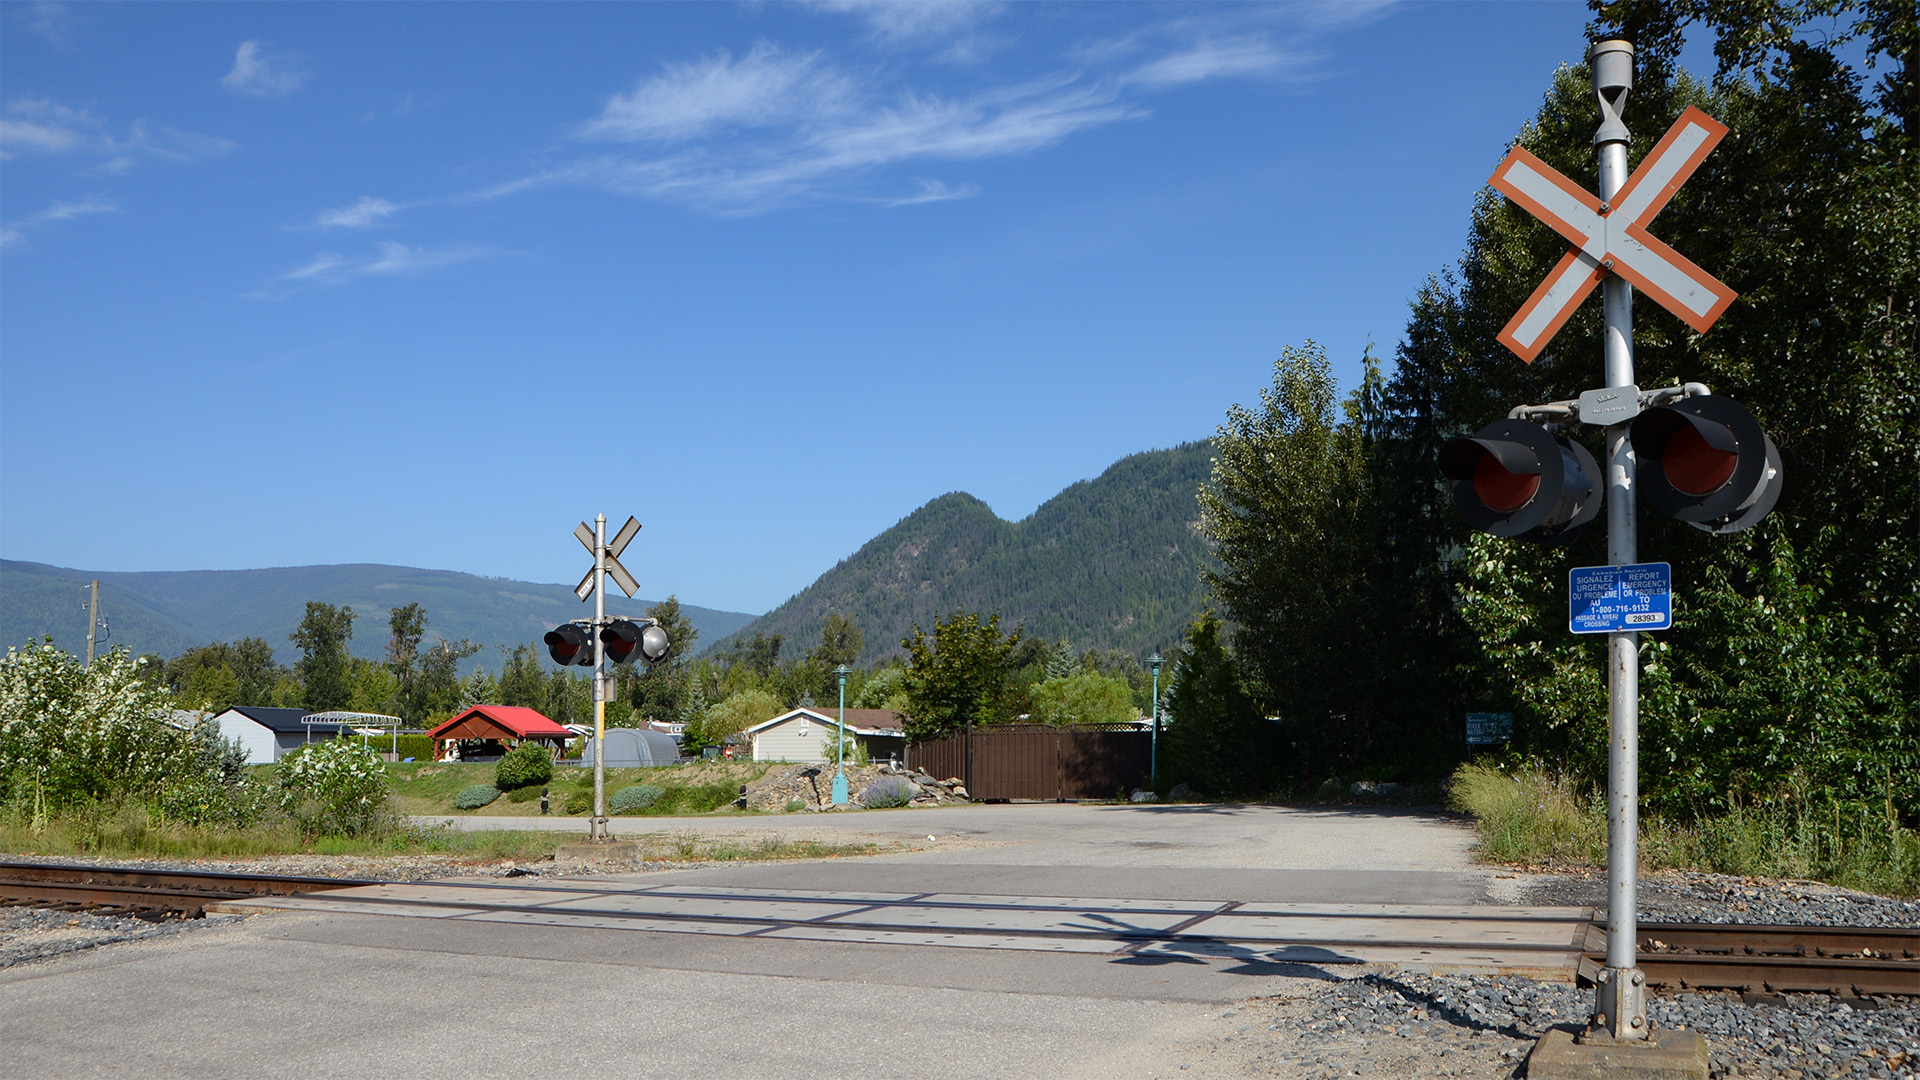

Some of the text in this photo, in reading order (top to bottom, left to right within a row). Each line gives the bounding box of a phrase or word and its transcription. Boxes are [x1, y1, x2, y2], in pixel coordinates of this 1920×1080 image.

[1576, 575, 1614, 584] SIGNALEZ
[1629, 572, 1660, 581] REPORT
[1576, 583, 1614, 592] URGENCE
[1622, 580, 1667, 589] EMERGENCY
[1572, 592, 1582, 600] OU
[1623, 588, 1667, 597] OR PROBLEM
[1590, 599, 1601, 607] AU
[1639, 596, 1651, 604] TO
[1591, 604, 1650, 614] 1-800-716-9132
[1633, 614, 1656, 623] 28393
[1583, 620, 1610, 628] CROSSING
